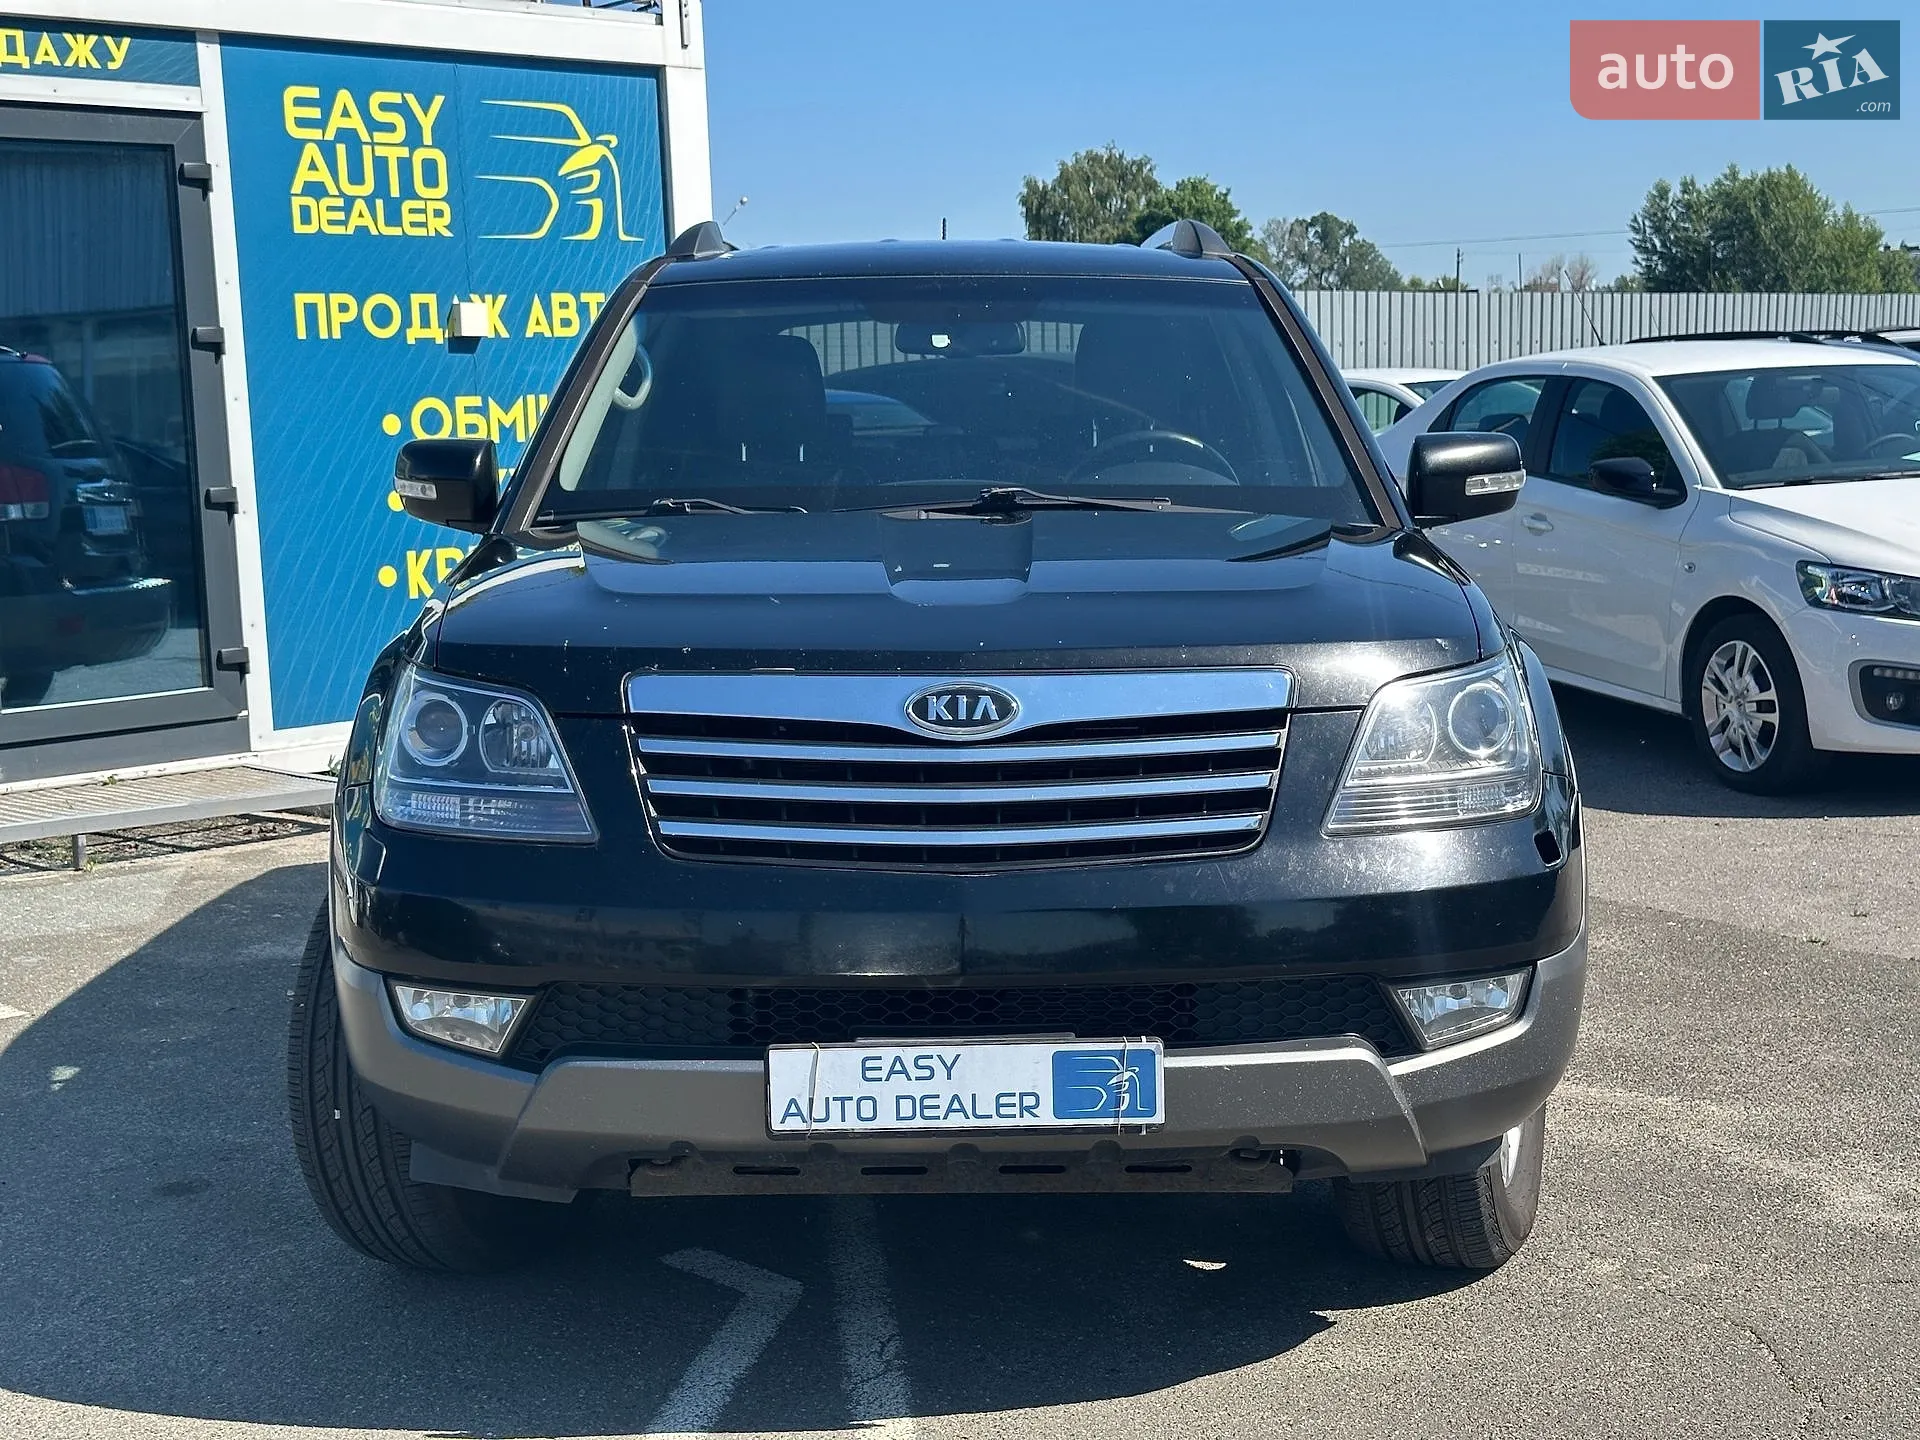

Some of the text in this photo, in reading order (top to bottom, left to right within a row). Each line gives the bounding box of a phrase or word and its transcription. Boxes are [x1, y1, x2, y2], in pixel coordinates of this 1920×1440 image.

[283, 85, 446, 146] EASY
[290, 142, 449, 200] AUTO
[291, 196, 454, 237] DEALER
[294, 293, 510, 344] ПРОДЖ
[926, 695, 1000, 720] KIA
[861, 1054, 961, 1082] EASY
[780, 1092, 1040, 1124] AUTO DEALER
